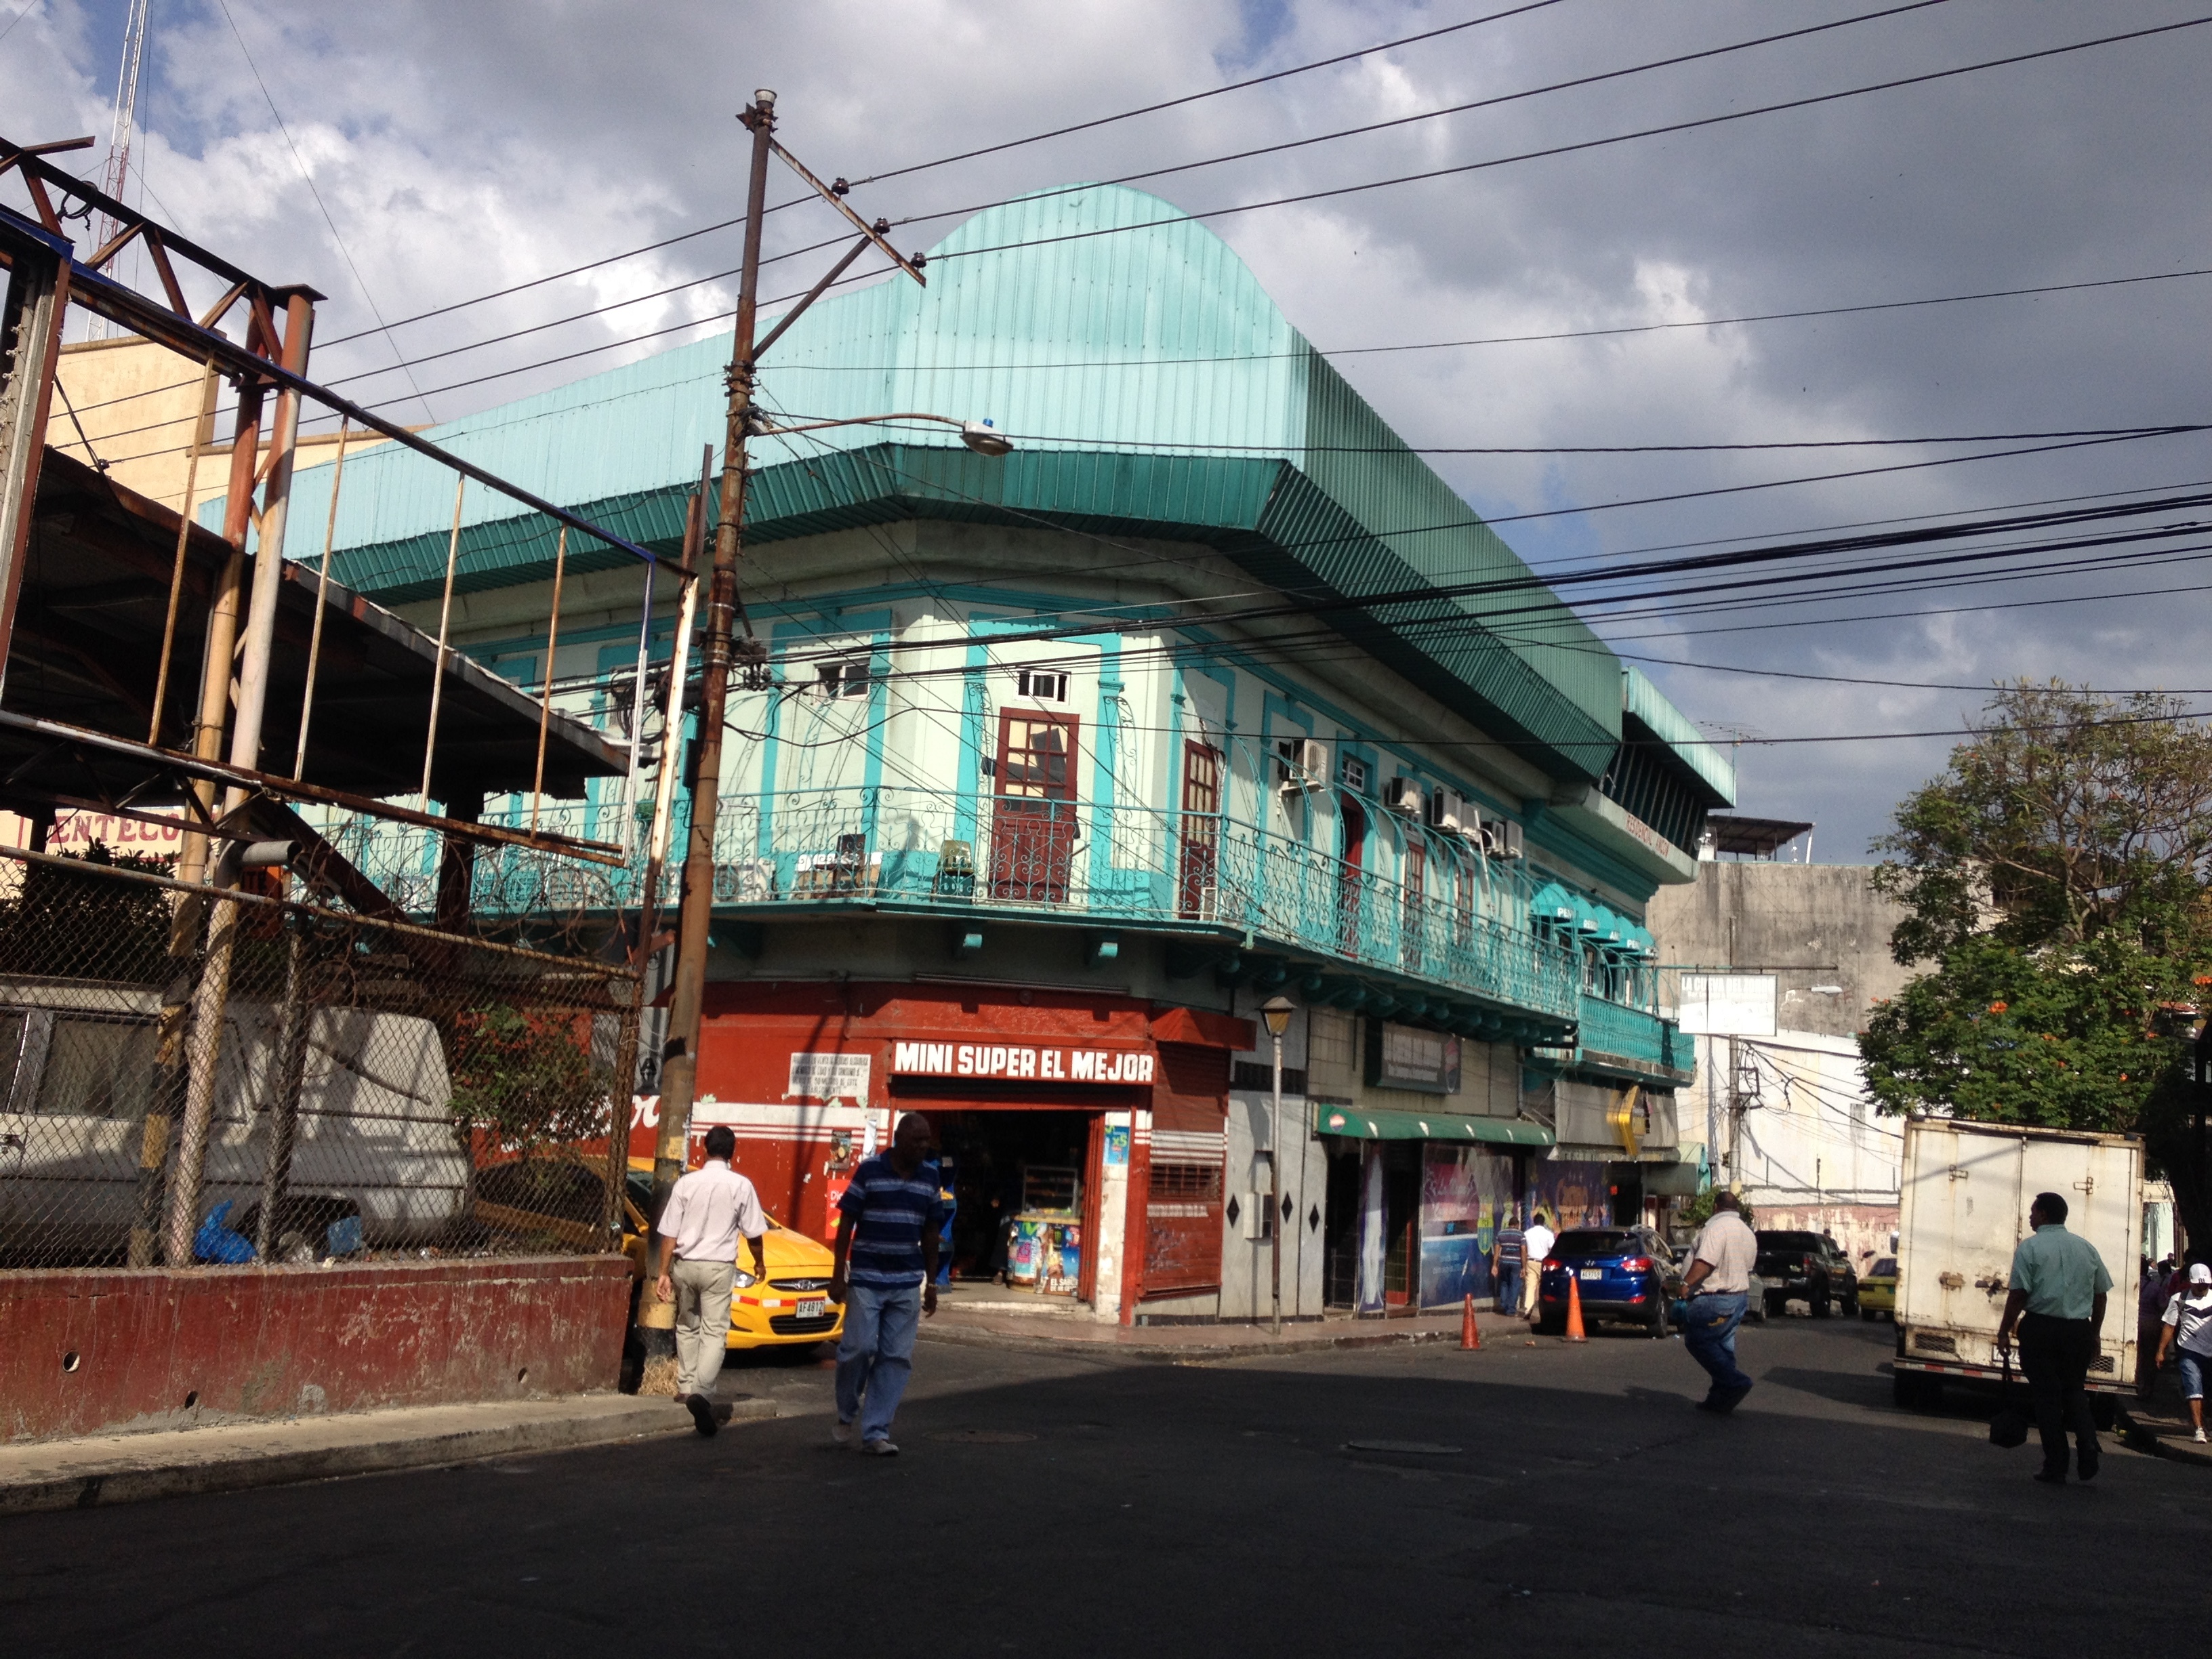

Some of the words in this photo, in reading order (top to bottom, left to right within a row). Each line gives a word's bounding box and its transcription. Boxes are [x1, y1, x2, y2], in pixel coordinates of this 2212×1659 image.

[47, 813, 182, 844] ENTECO
[1681, 977, 1692, 991] LA
[895, 1042, 954, 1073] MINI
[958, 1046, 1036, 1078] SUPER
[1040, 1049, 1065, 1079] EL
[1071, 1050, 1154, 1082] MEJOR
